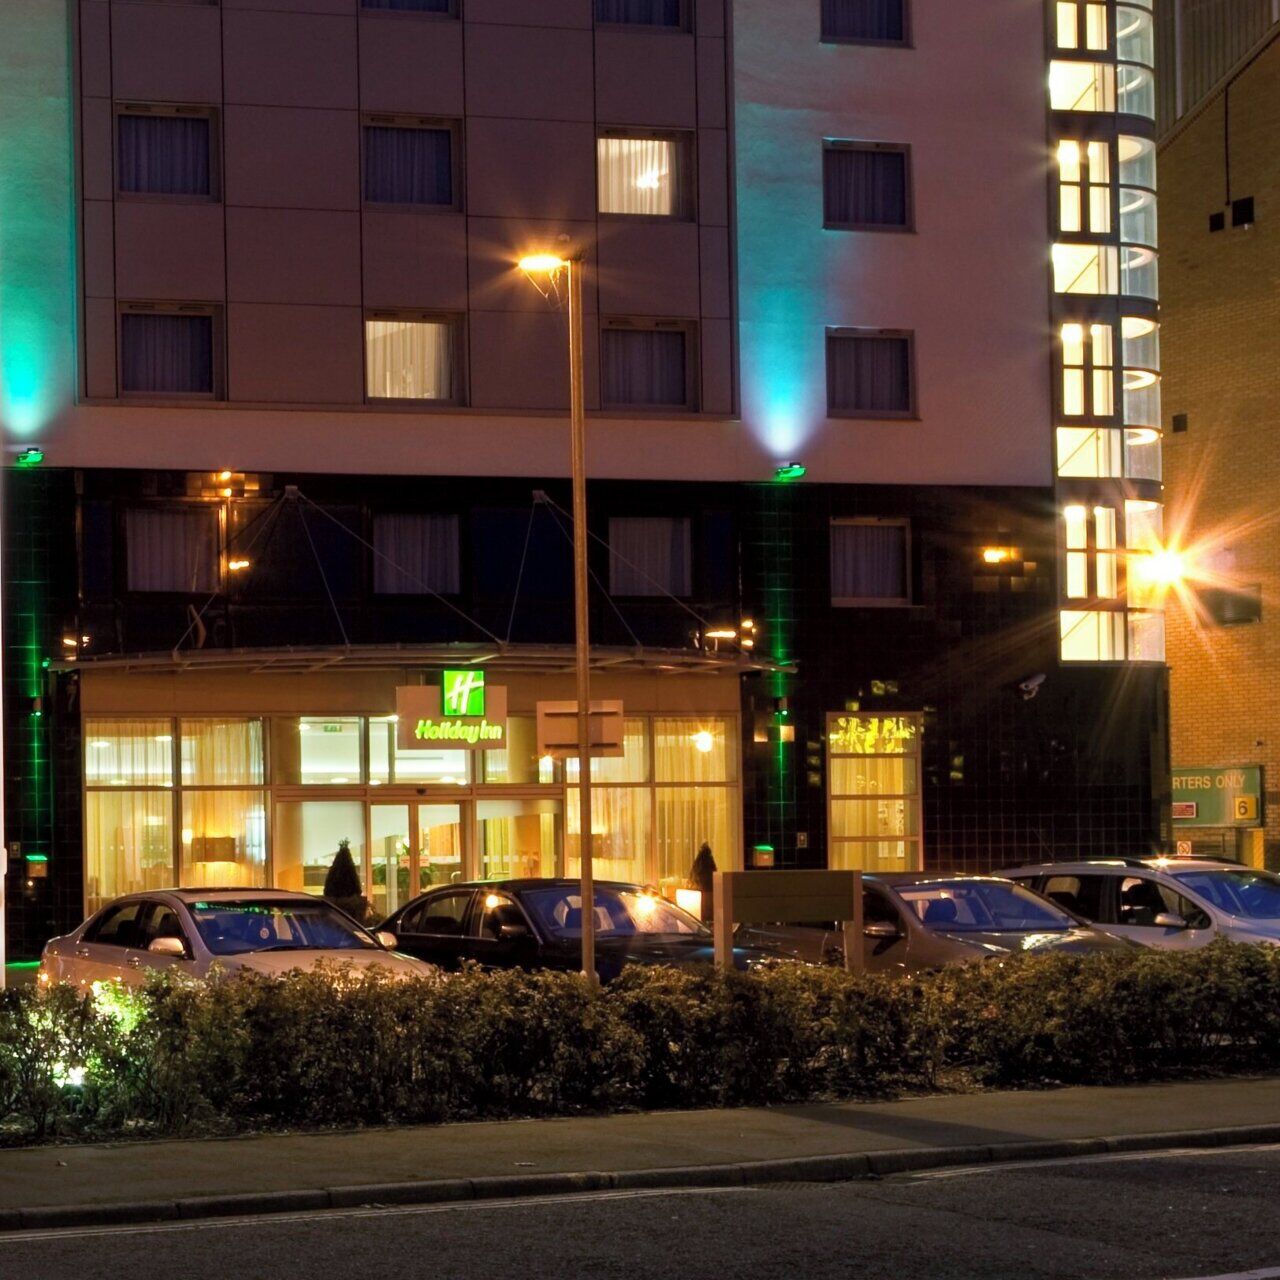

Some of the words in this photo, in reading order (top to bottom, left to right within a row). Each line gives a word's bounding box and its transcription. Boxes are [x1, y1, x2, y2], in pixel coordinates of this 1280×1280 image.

[415, 720, 480, 744] Holiday
[480, 720, 502, 739] Inn
[1215, 775, 1245, 788] ONLY
[1238, 800, 1248, 816] 6
